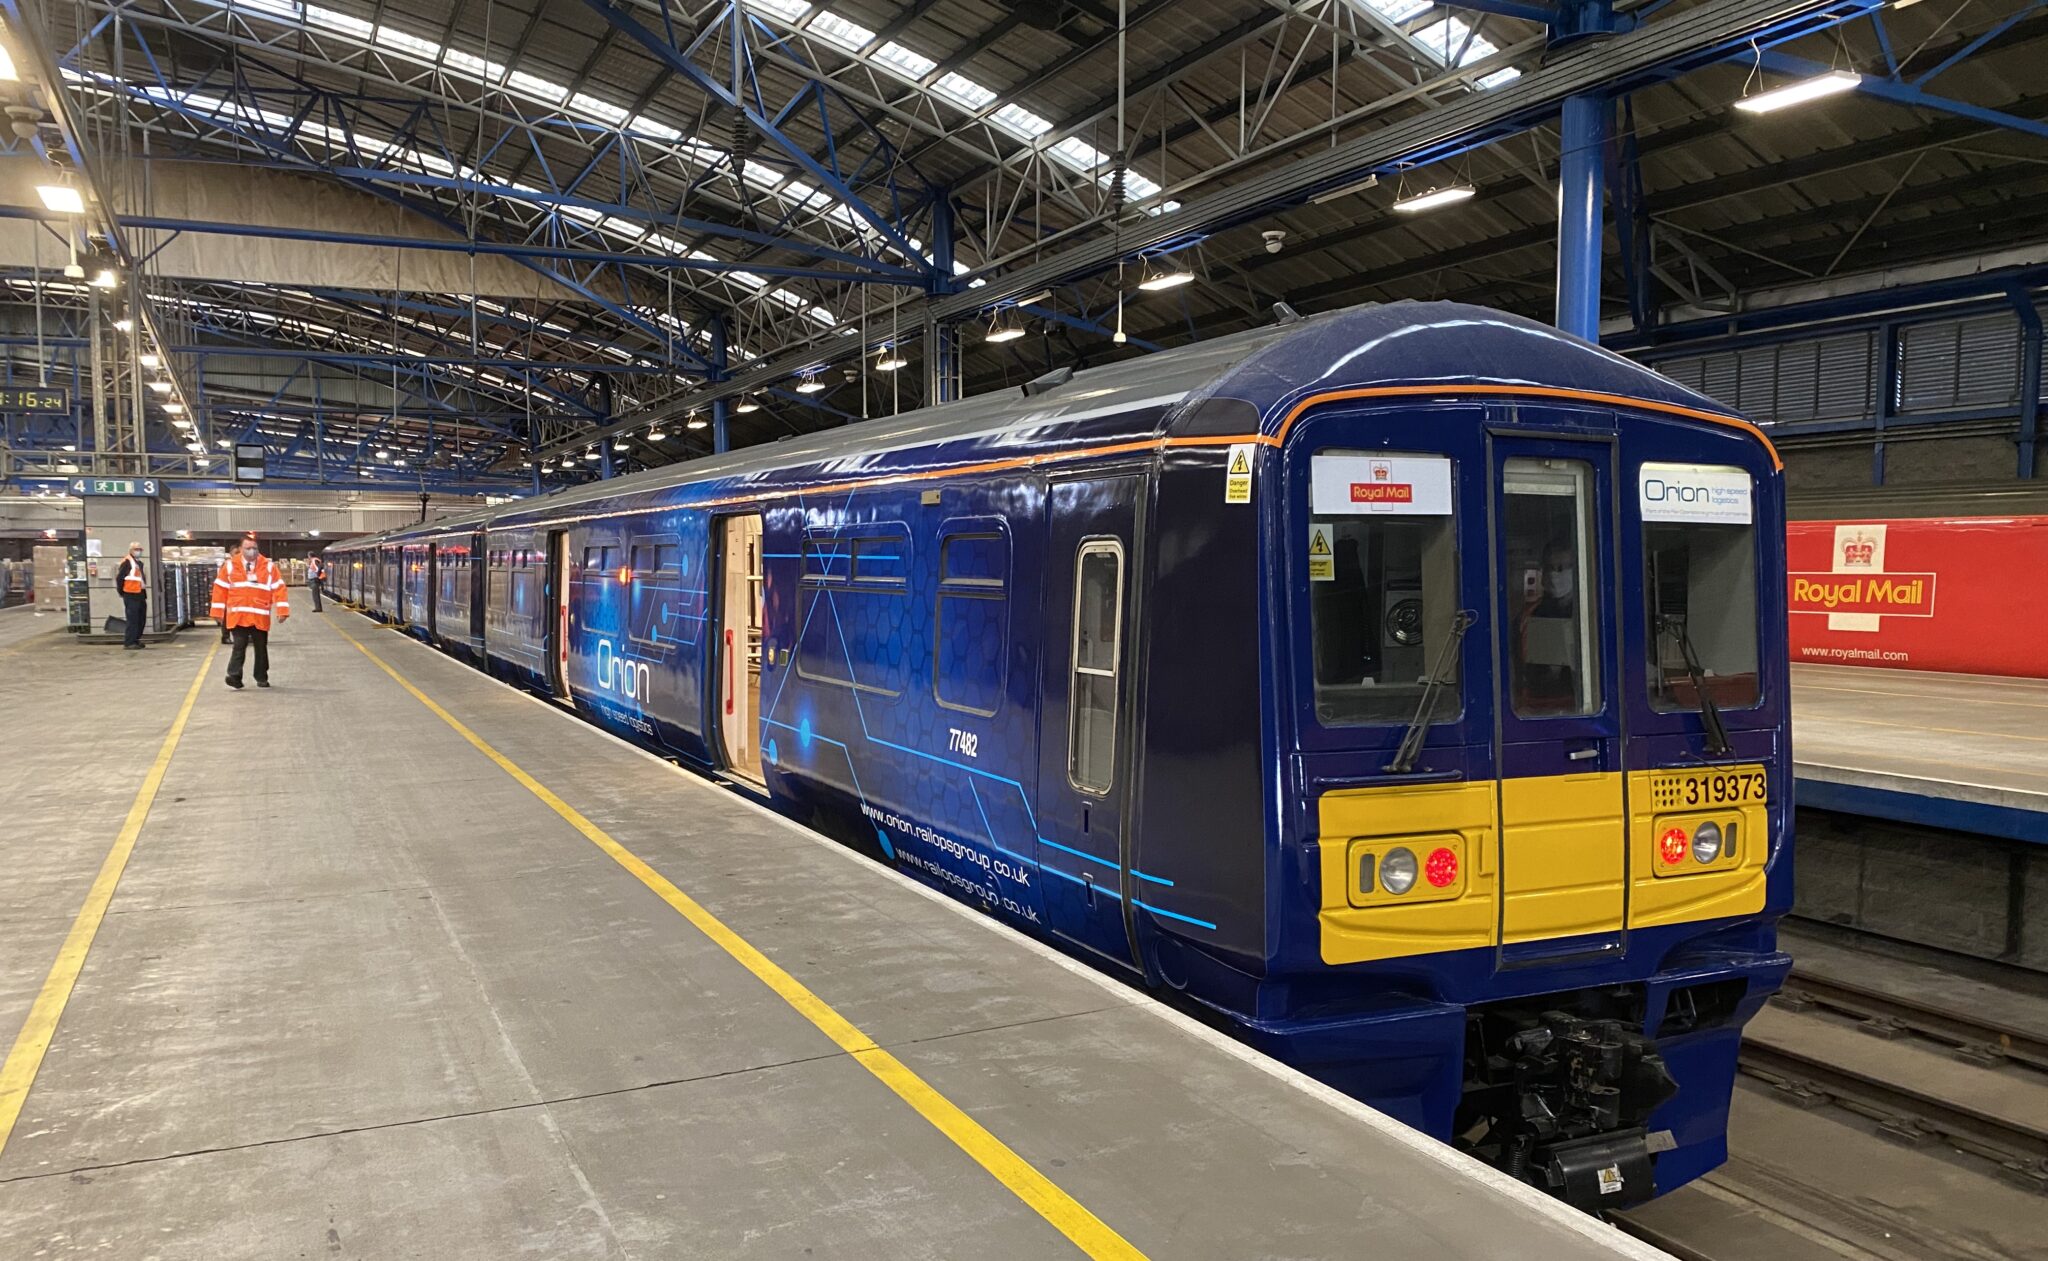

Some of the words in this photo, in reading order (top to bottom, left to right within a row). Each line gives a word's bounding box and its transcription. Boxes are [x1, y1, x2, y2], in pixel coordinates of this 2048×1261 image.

[73, 479, 86, 493] 4
[144, 481, 155, 494] 3
[1353, 486, 1384, 500] Royal
[1386, 487, 1409, 498] Mail
[1645, 480, 1709, 502] Orion
[1794, 579, 1861, 607] Royal
[1866, 580, 1923, 604] Mail
[1802, 647, 1909, 661] www.royalmail.com
[598, 639, 650, 703] Orion
[950, 728, 978, 757] 77482
[1686, 773, 1765, 804] 319373
